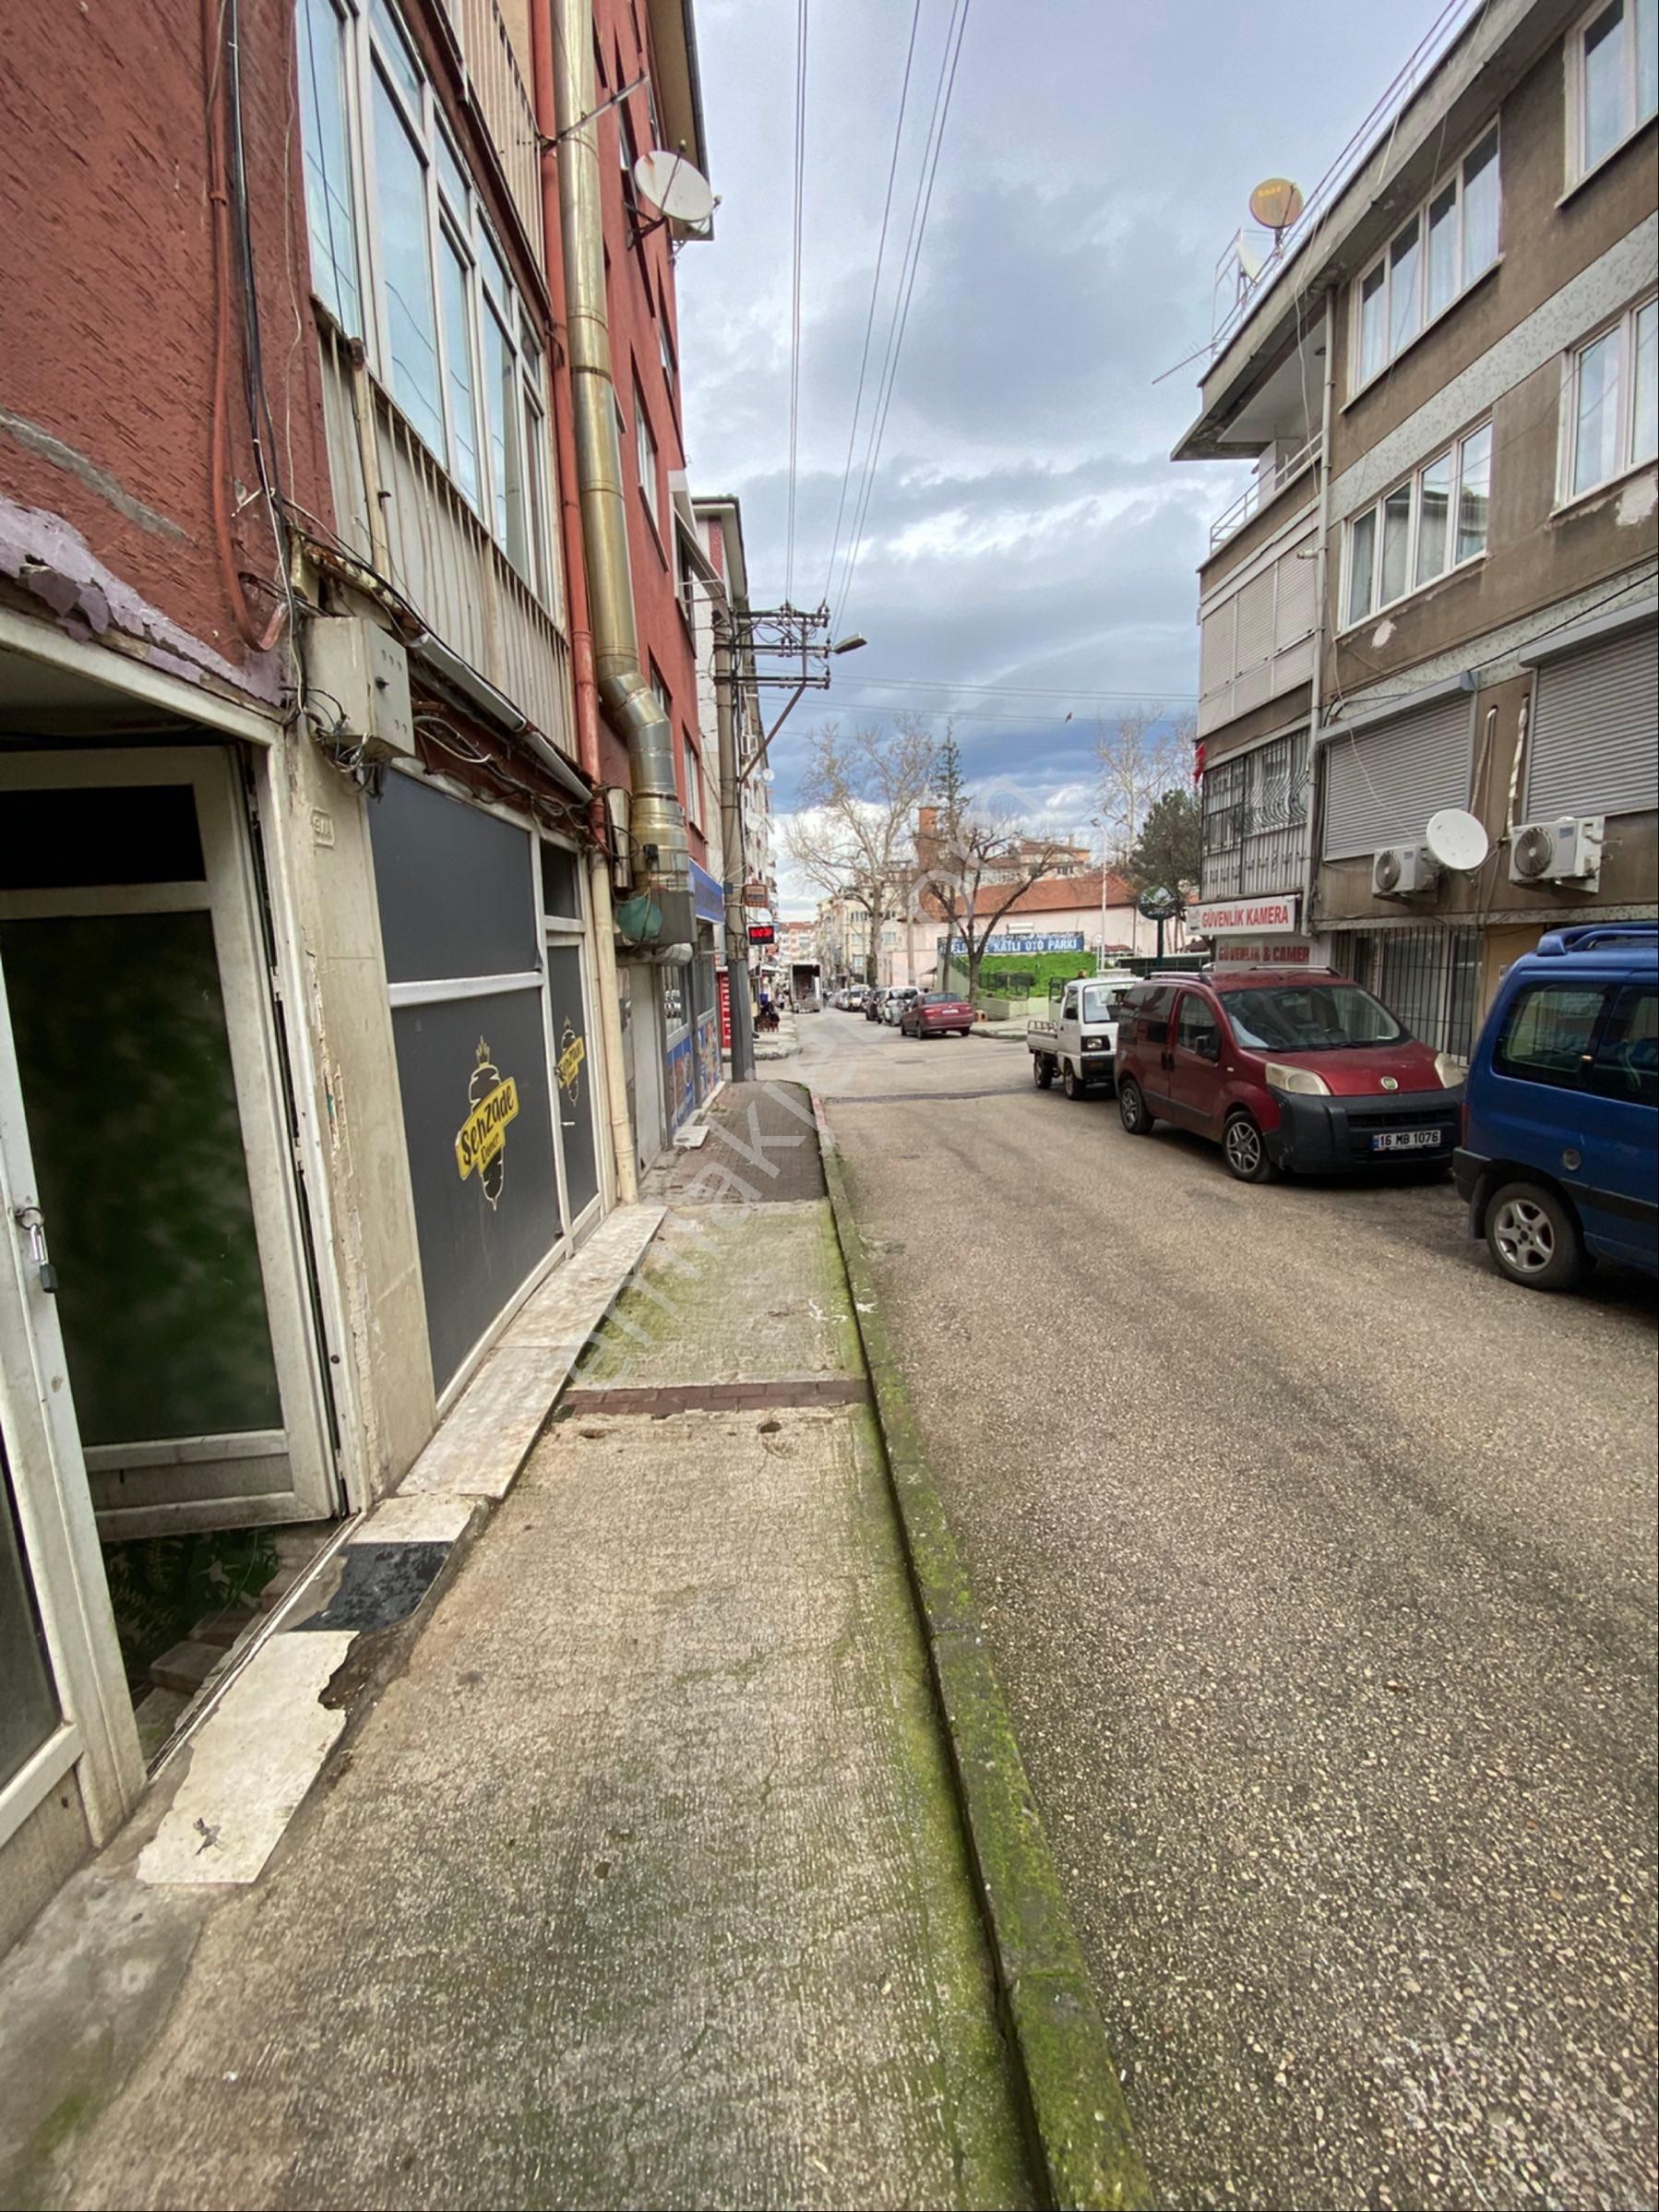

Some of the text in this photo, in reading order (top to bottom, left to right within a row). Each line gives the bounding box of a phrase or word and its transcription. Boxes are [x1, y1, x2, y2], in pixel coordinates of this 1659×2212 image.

[1201, 904, 1289, 928] GÜVENLİK KAMERA
[1047, 939, 1077, 951] PARKI
[1380, 1131, 1438, 1146] 16 MB 1076
